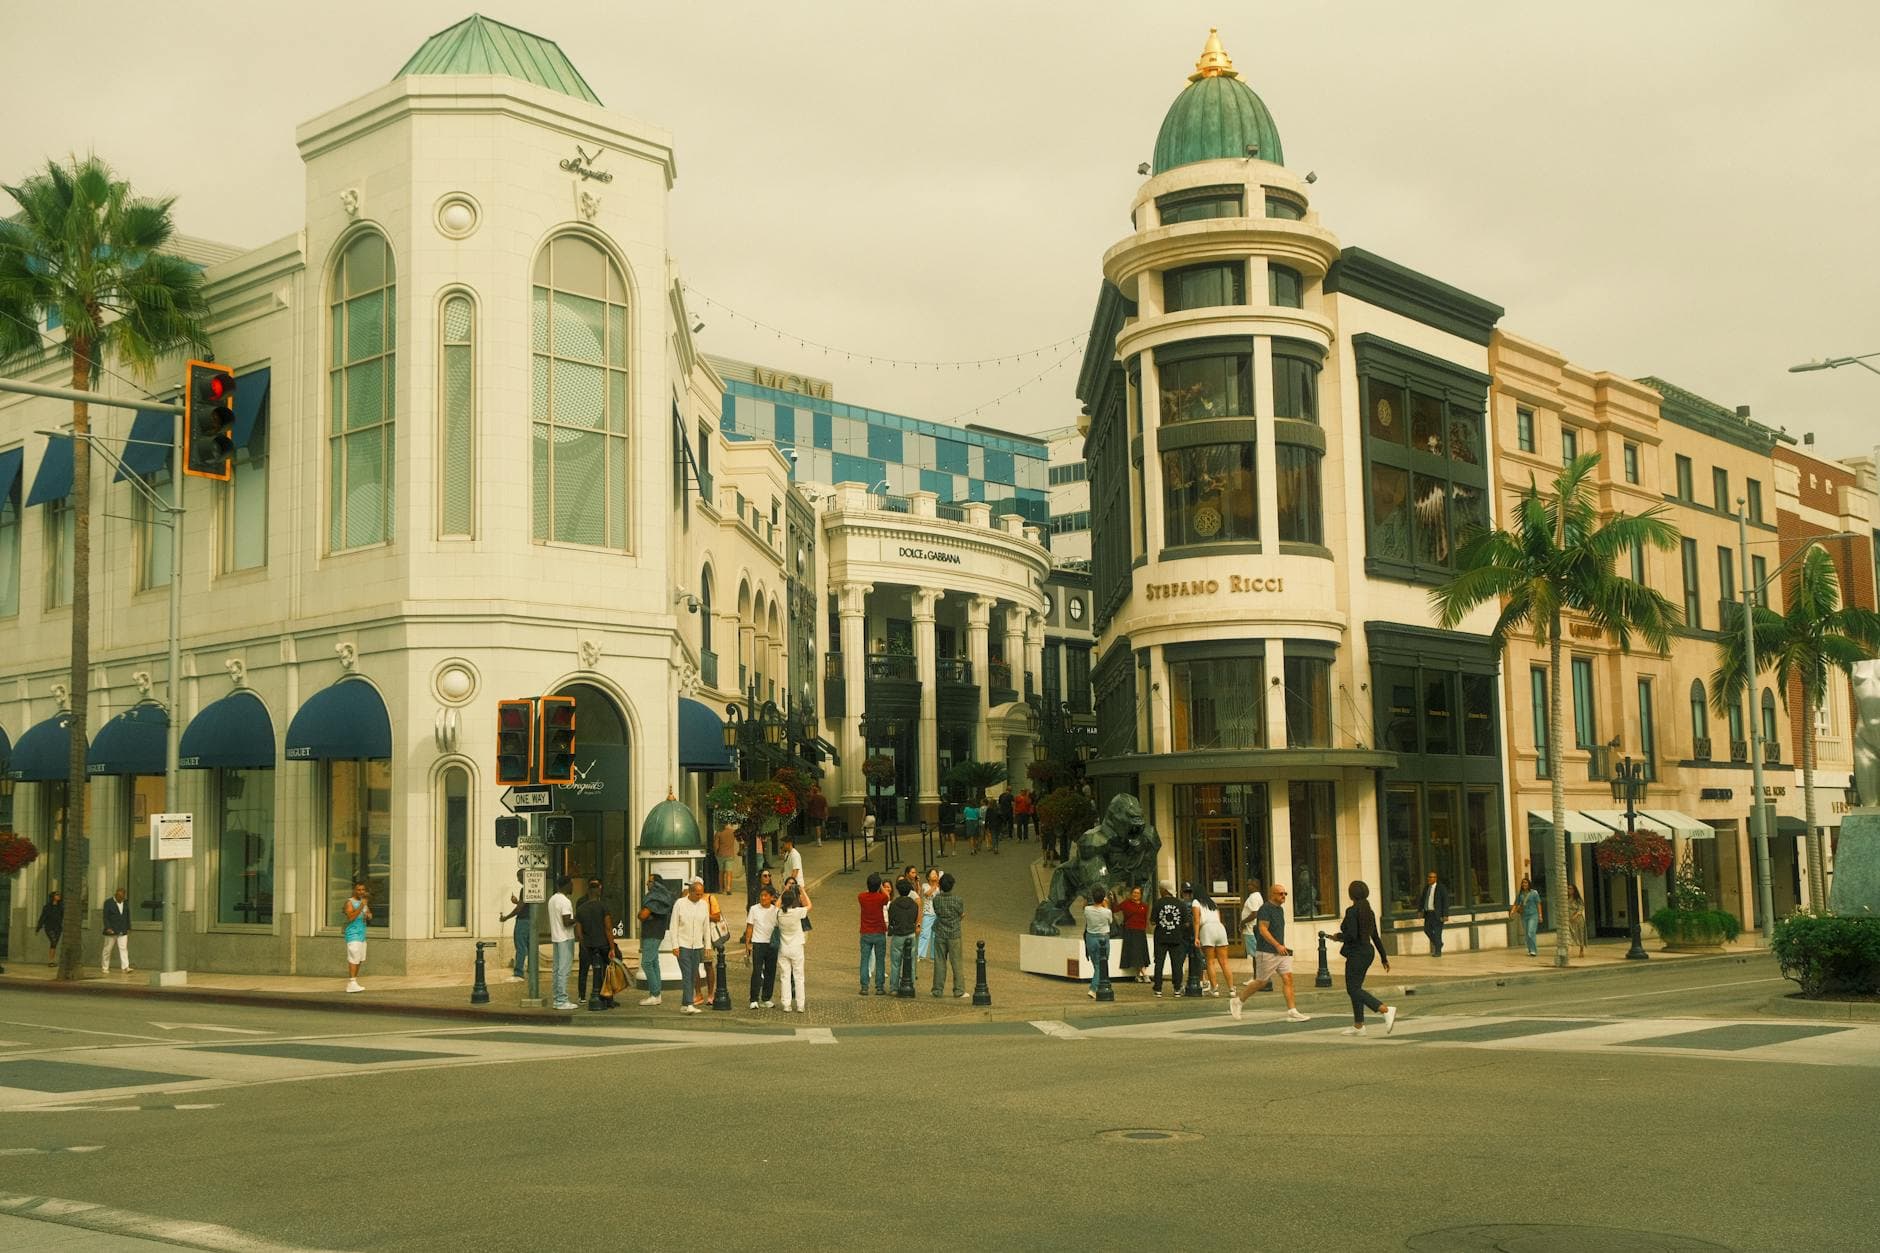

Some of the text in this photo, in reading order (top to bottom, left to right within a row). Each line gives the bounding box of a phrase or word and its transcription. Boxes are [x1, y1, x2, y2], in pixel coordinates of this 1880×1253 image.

[753, 367, 832, 400] MGM
[1146, 574, 1284, 601] STEFANO RICCI
[515, 793, 546, 805] ONE WAY
[518, 854, 530, 864] OK
